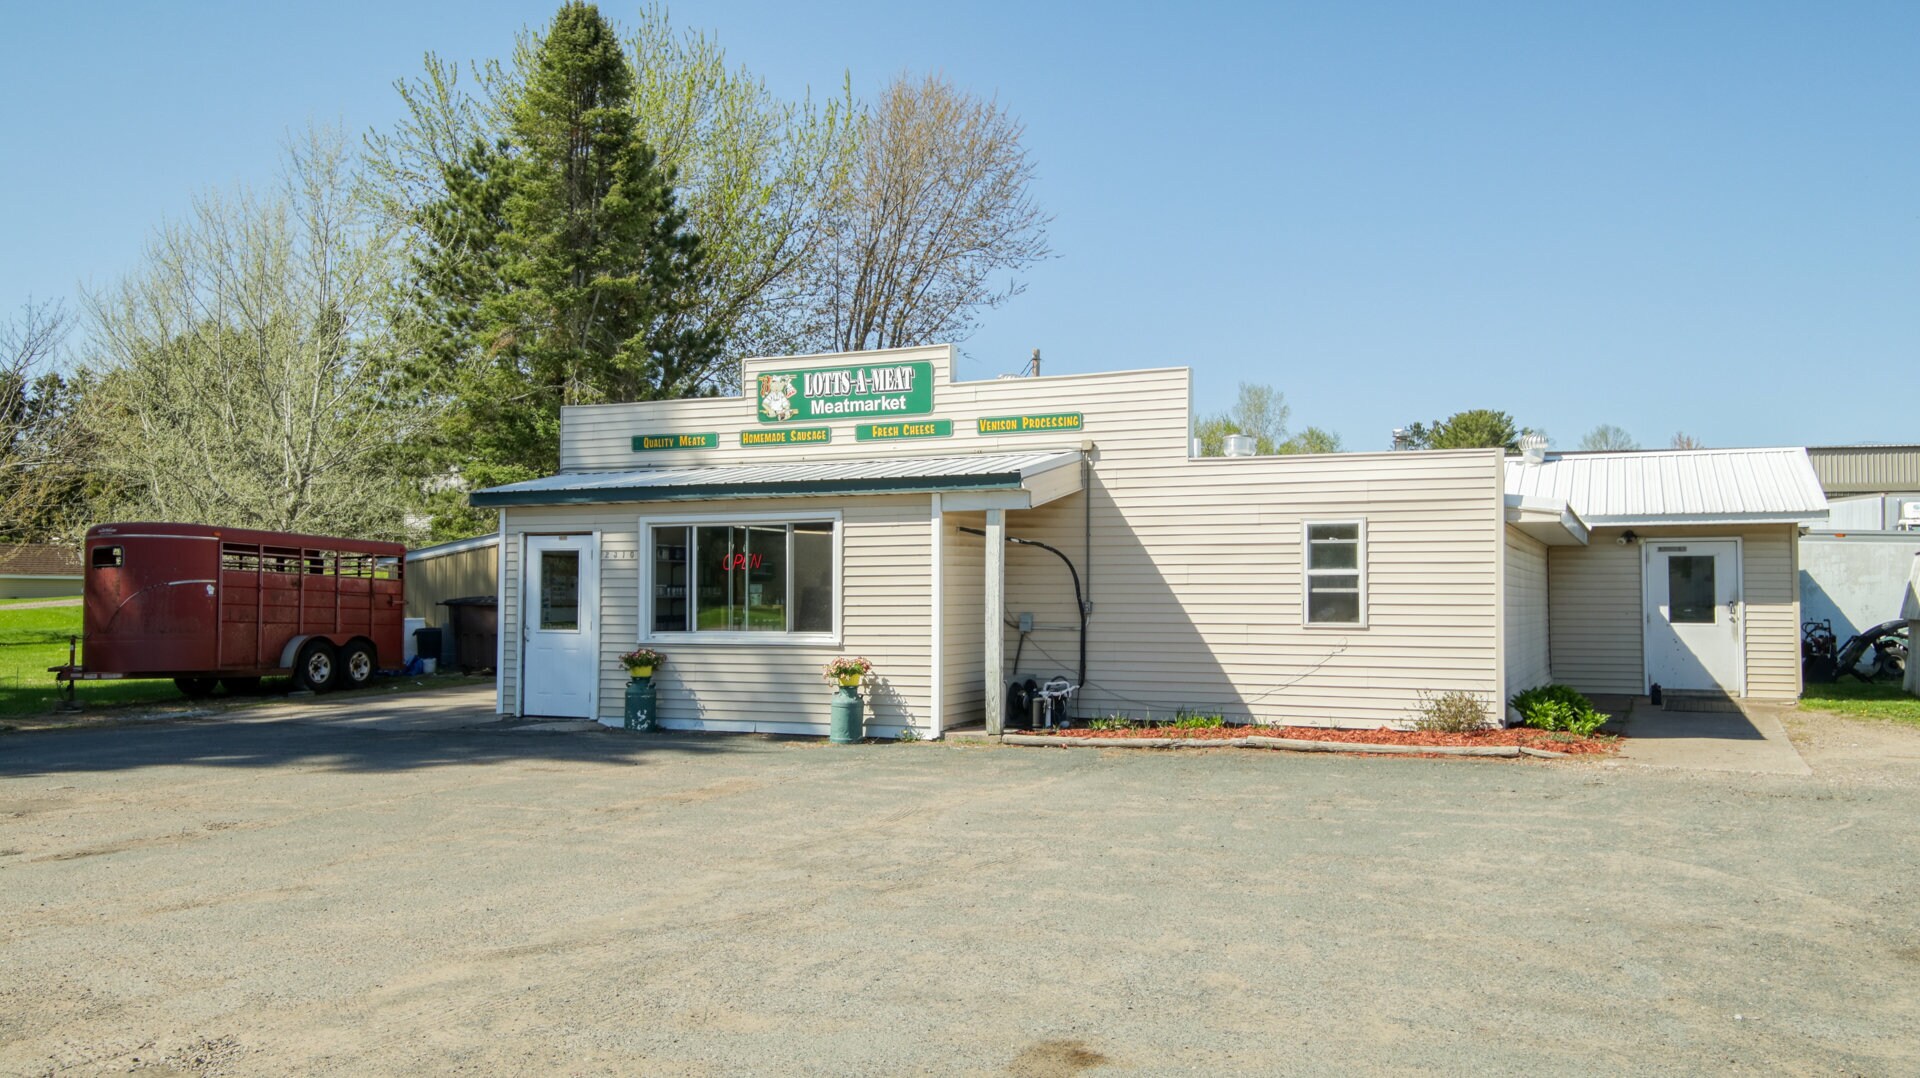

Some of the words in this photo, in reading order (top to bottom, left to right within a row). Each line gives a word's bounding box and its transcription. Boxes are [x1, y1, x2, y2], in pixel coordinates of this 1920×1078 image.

[804, 365, 915, 397] LOTTS-A-MEAT
[811, 396, 906, 415] Meatmarket
[872, 424, 899, 438] FRESH
[903, 423, 935, 436] CHEESE
[979, 418, 1017, 432] VENISON
[1022, 415, 1079, 429] PROCESSING
[643, 436, 674, 449] QUALITY
[679, 435, 706, 447] MEATS
[742, 431, 786, 445] HOMEMADE
[790, 430, 827, 442] SAUSAGE
[722, 553, 763, 571] OPEN
